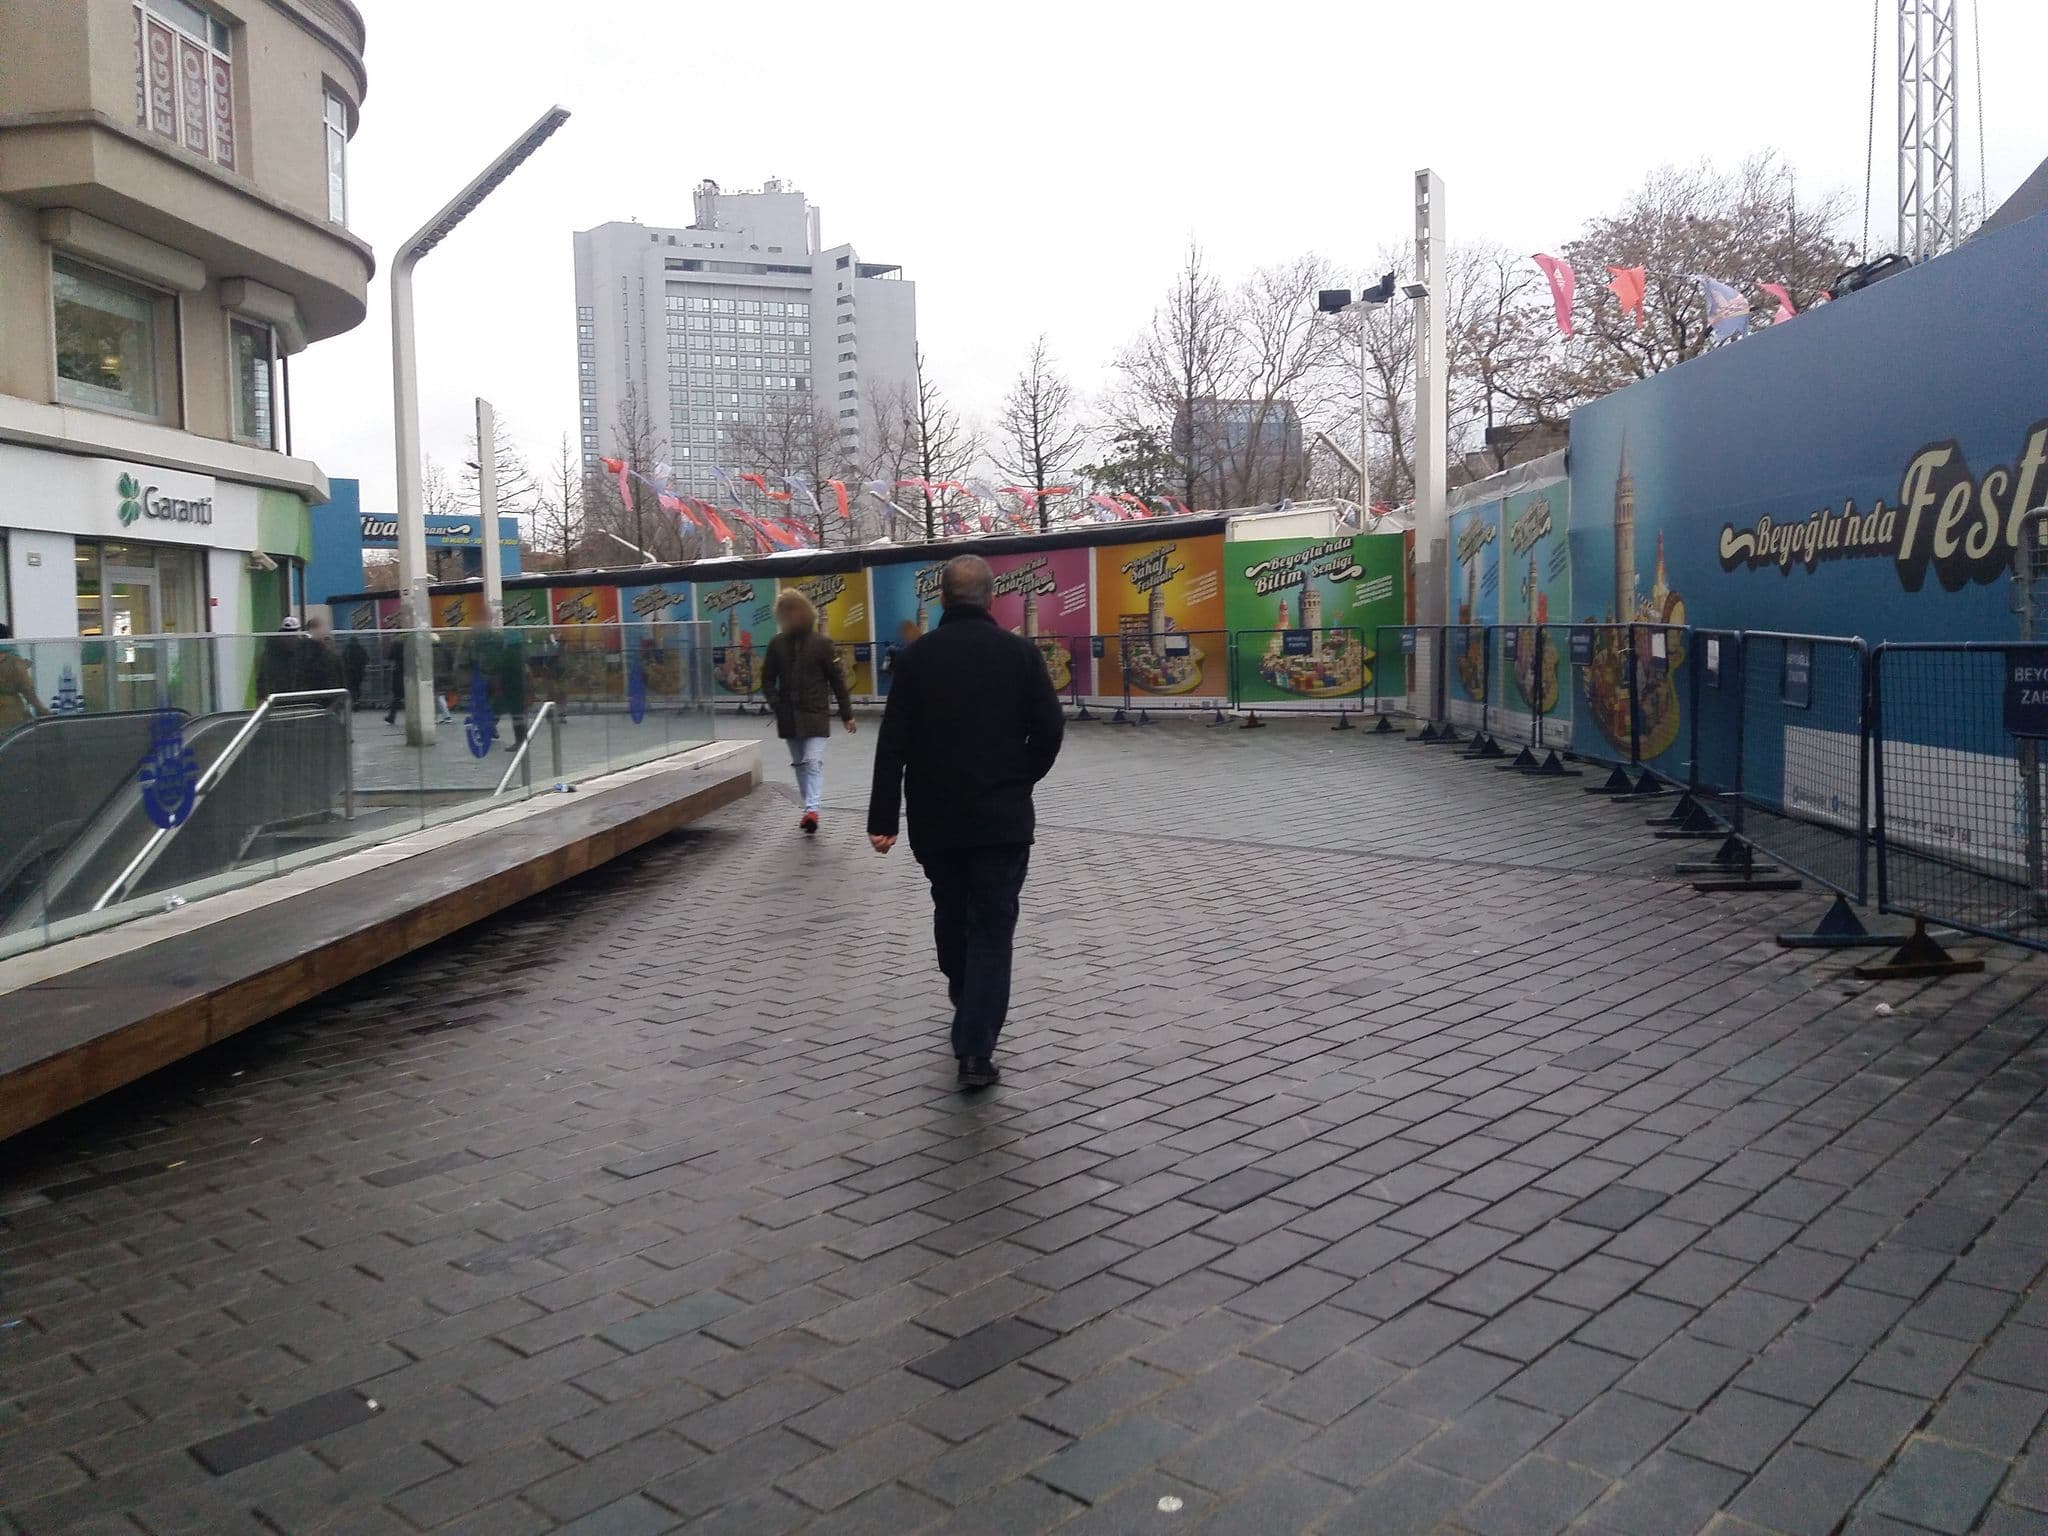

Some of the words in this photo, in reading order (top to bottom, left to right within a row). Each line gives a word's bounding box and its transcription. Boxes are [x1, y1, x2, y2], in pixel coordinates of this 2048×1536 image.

[151, 32, 172, 135] ERGO
[183, 50, 204, 150] ERGO
[213, 65, 233, 162] ERGO
[144, 486, 213, 525] Garanti
[1757, 500, 1897, 566] Beyoğlu'nda
[1899, 428, 2048, 561] Fest
[1255, 570, 1303, 594] Bilim
